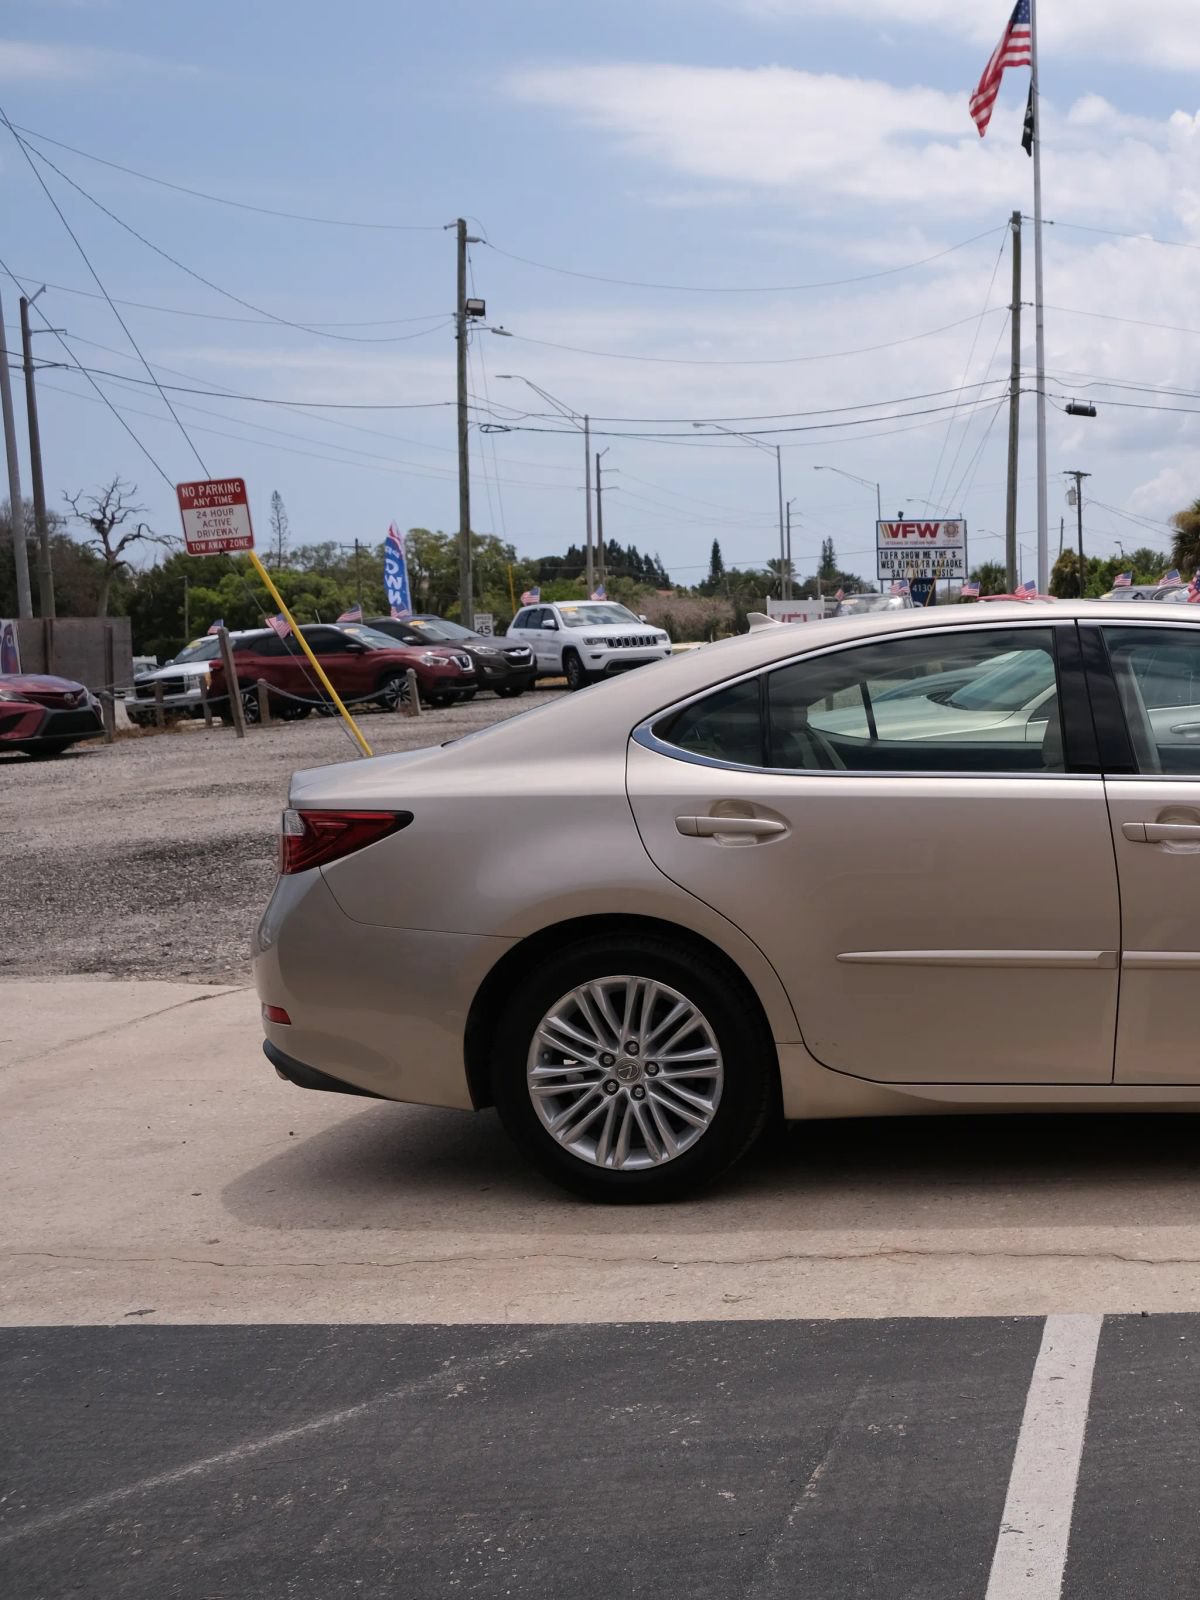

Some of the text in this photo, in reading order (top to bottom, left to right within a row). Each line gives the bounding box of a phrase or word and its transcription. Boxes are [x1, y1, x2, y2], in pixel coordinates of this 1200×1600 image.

[182, 482, 241, 497] NO PARKING
[193, 495, 234, 507] ANY TIME
[196, 508, 234, 519] 24 HOUR
[202, 518, 232, 528] ACTIVE
[197, 527, 239, 539] DRIVEWAY
[888, 523, 940, 538] VFW
[192, 538, 249, 551] TOW AWAY ZONE
[901, 551, 920, 559] SHOW
[923, 551, 932, 559] ME
[935, 551, 947, 559] THE
[881, 560, 894, 569] WED
[898, 560, 919, 568] BINGO
[932, 560, 962, 568] KARAOKE
[891, 569, 954, 578] SAT LIVE MUSIC
[476, 625, 492, 634] 45
